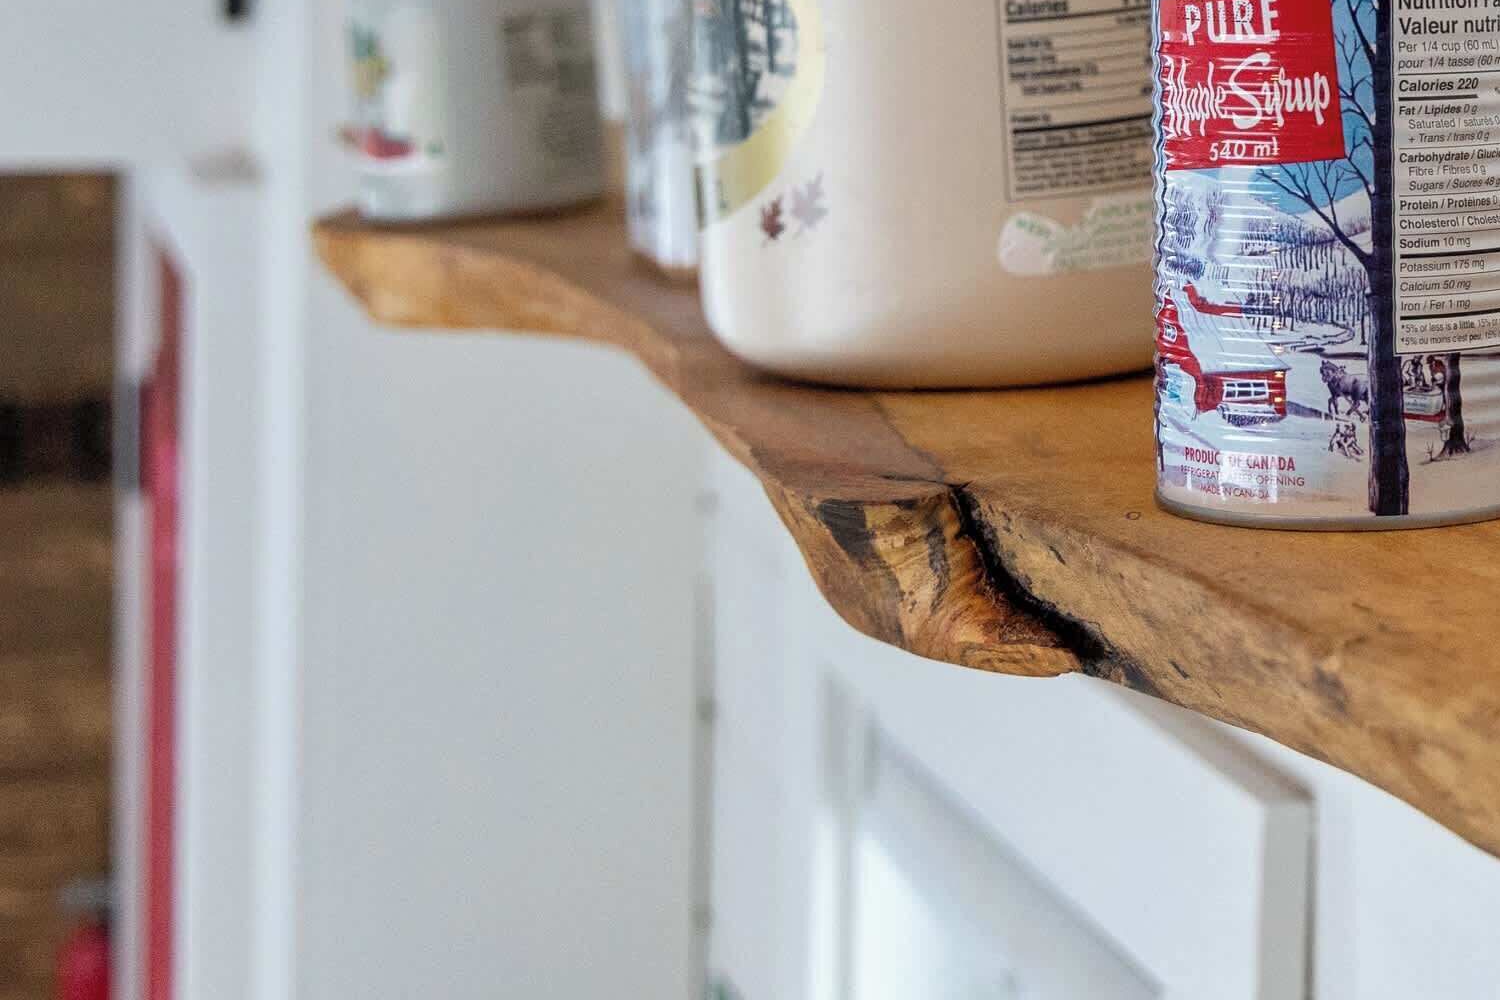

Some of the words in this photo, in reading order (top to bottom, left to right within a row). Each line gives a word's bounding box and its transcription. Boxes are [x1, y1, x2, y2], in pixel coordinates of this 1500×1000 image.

[1006, 0, 1067, 15] Calories
[1399, 17, 1458, 35] Valeur
[1399, 41, 1417, 53] Per
[1422, 41, 1438, 52] 1/4
[1441, 42, 1460, 54] cup
[1464, 39, 1479, 53] (60
[1482, 39, 1499, 52] mL)
[1398, 58, 1424, 70] pour
[1429, 57, 1444, 68] 1/4
[1448, 56, 1475, 68] tasse
[1477, 54, 1491, 68] (60
[1399, 79, 1454, 92] Calories
[1457, 77, 1479, 90] 220
[1164, 55, 1227, 137] Maple
[1229, 52, 1331, 129] Syrup
[1399, 105, 1415, 116] Fat
[1424, 104, 1461, 117] Lipides
[1463, 104, 1470, 114] 0
[1471, 105, 1478, 116] g
[1408, 118, 1456, 129] Saturated
[1419, 133, 1445, 143] Trans
[1453, 131, 1475, 142] trans
[1210, 140, 1246, 161] 540
[1400, 151, 1470, 164] Carbohydrate
[1408, 166, 1433, 176] Fibre
[1443, 164, 1470, 175] Fibres
[1472, 164, 1479, 174] 0
[1409, 180, 1444, 192] Sugars
[1452, 178, 1483, 189] Sucres
[1400, 199, 1438, 210] Protein
[1400, 217, 1459, 230] Cholesterol
[1400, 238, 1440, 249] Sodium
[1443, 237, 1454, 247] 10
[1456, 237, 1471, 248] mg
[1400, 261, 1451, 273] Potassium
[1454, 260, 1470, 270] 175
[1472, 259, 1485, 270] mg
[1400, 281, 1440, 292] Calcium
[1442, 280, 1455, 290] 50
[1456, 279, 1472, 290] mg
[1401, 301, 1420, 312] Iron
[1429, 300, 1445, 310] Fer
[1456, 299, 1471, 310] mg
[1429, 322, 1444, 332] less
[1446, 322, 1452, 331] is
[1430, 335, 1451, 344] moins
[1185, 446, 1224, 466] PRODUC
[1246, 455, 1296, 472] CANADA
[1200, 483, 1220, 496] MADE
